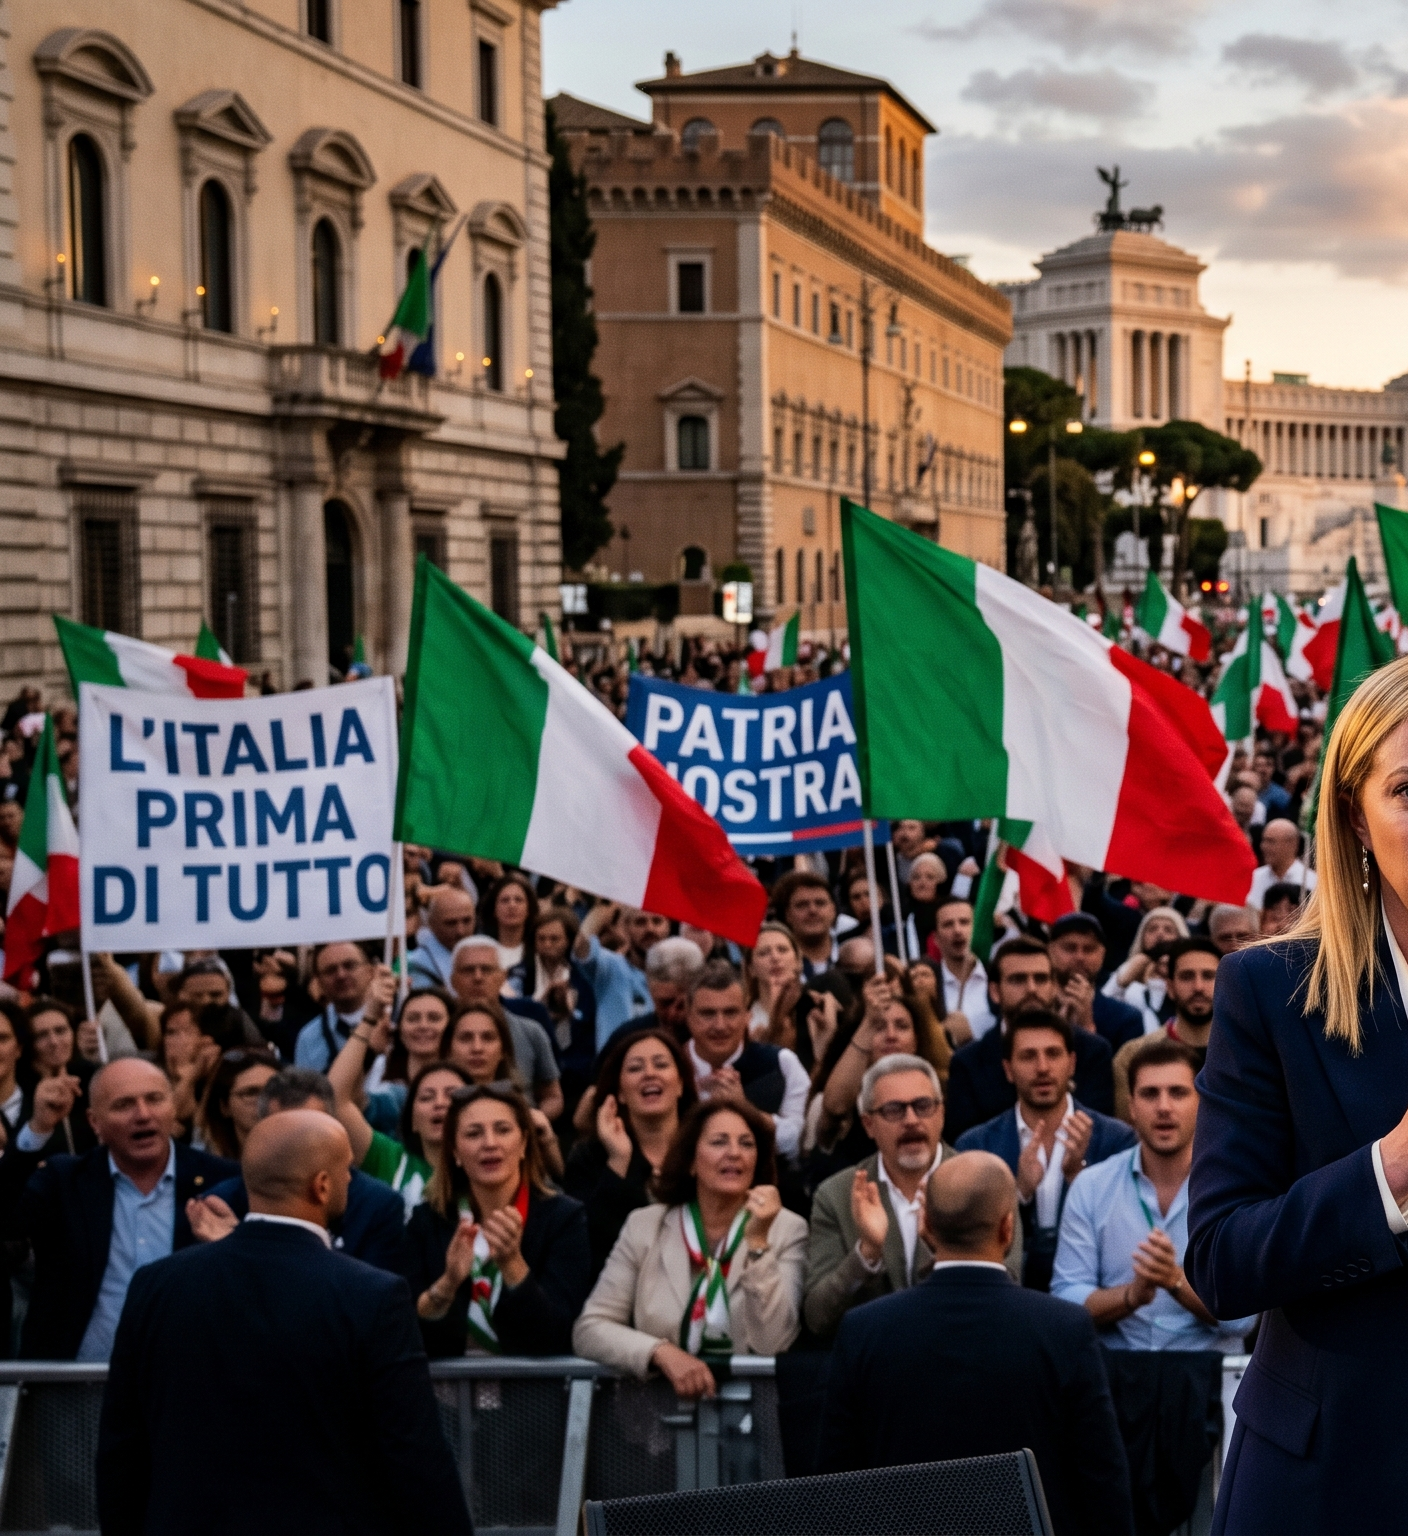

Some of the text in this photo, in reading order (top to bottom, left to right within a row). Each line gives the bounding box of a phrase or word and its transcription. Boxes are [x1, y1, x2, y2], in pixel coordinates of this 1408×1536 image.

[109, 707, 376, 777] L'ITALIA
[643, 689, 857, 763] PATRIA
[136, 783, 357, 849] PRIMA
[666, 752, 863, 823] OSTRA
[92, 852, 391, 926] DI TUTTO
